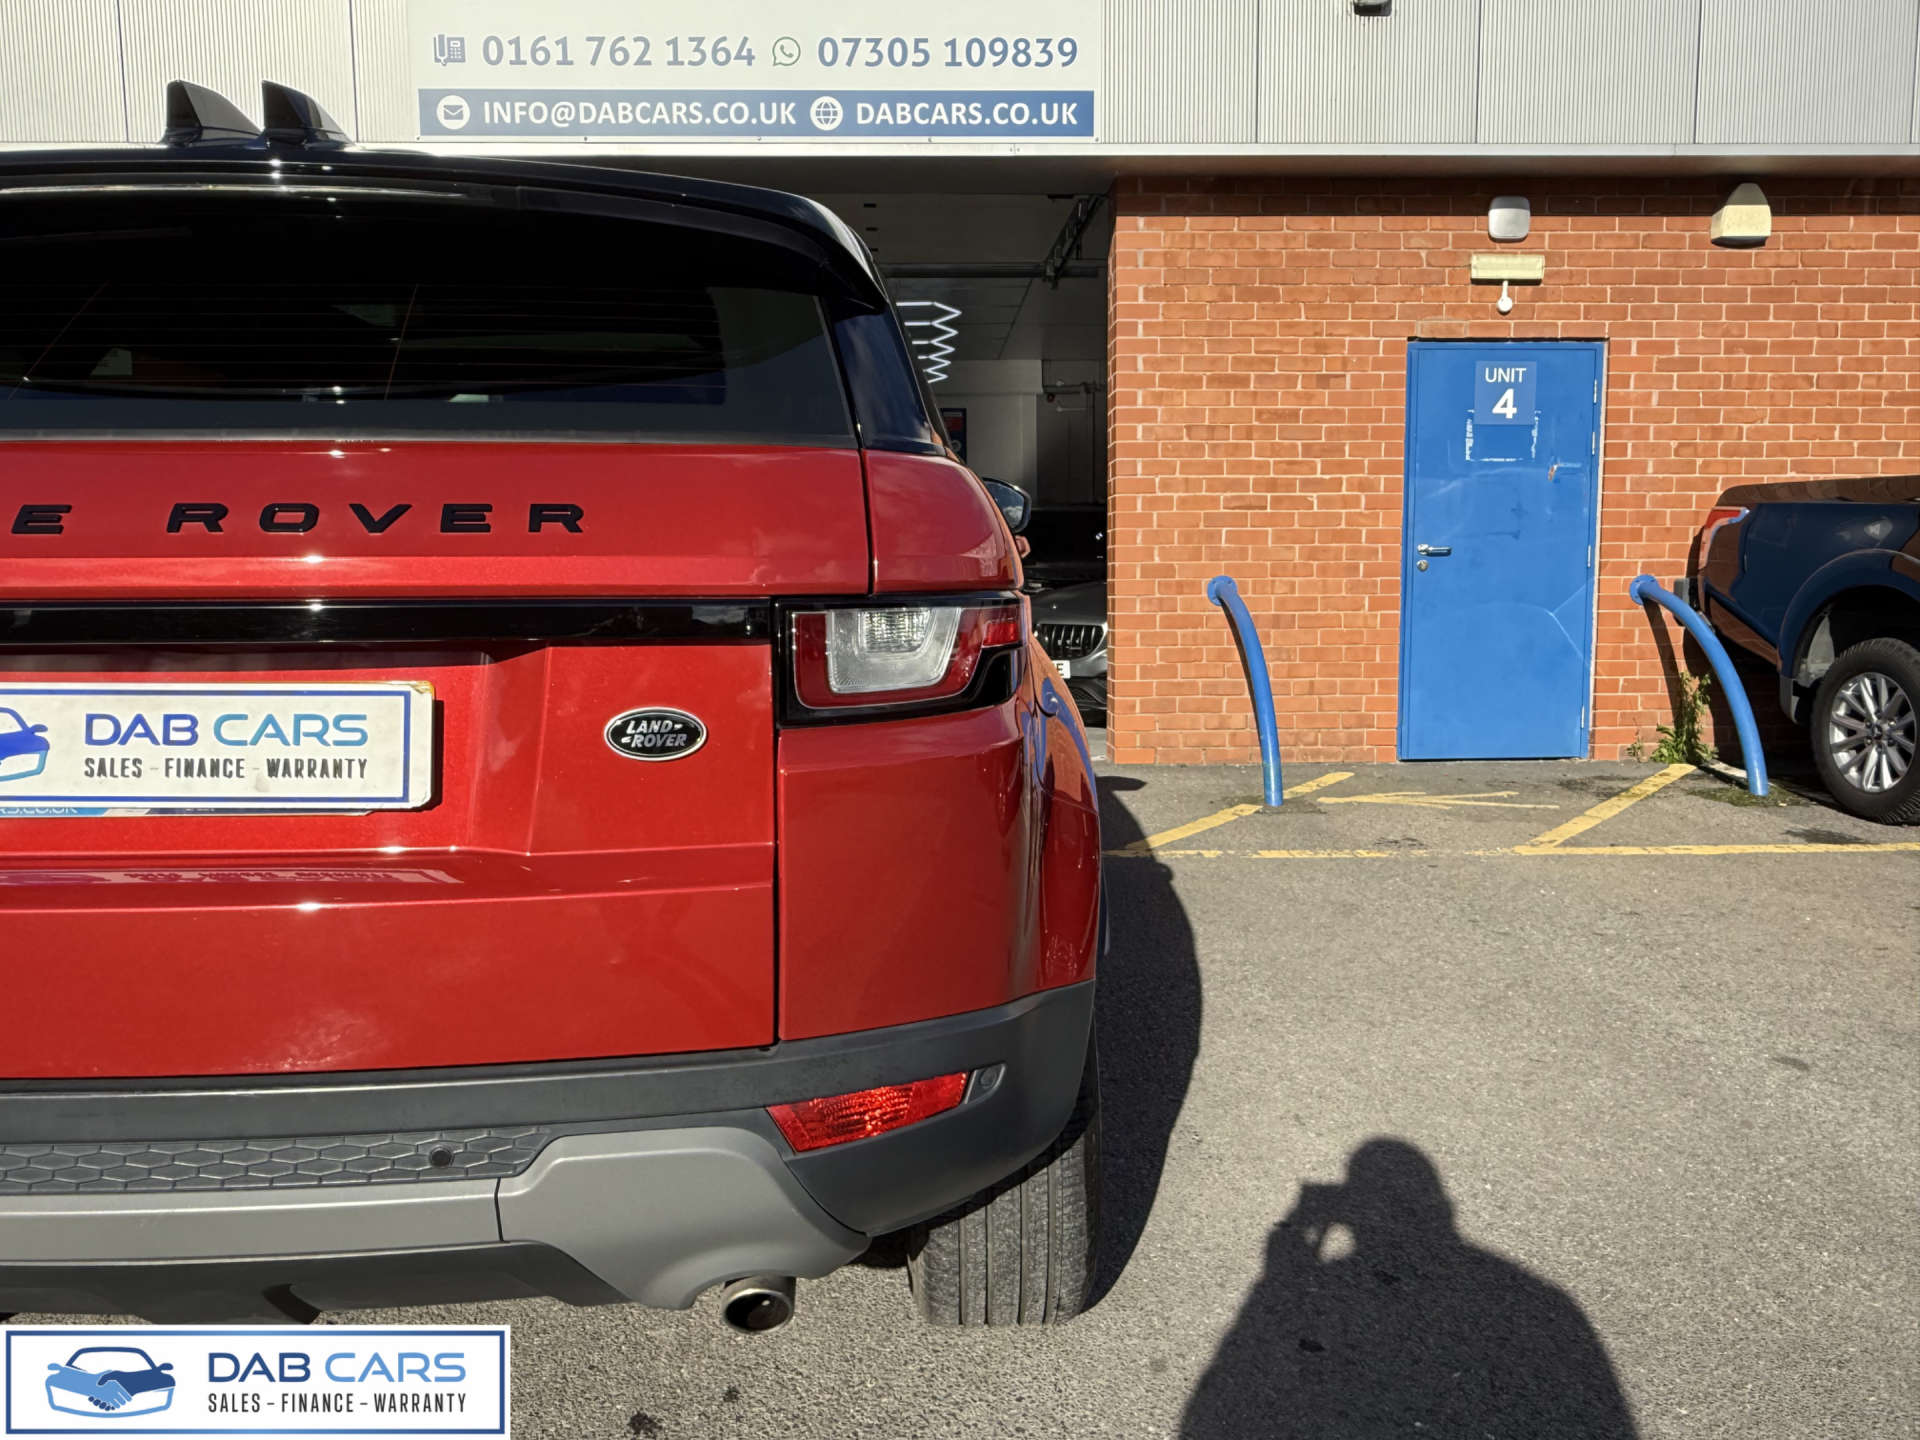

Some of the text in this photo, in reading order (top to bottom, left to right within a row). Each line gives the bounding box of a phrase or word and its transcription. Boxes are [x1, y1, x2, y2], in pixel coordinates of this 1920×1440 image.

[483, 35, 756, 67] 0161 762 1364
[818, 36, 1078, 67] 07305 109839
[484, 101, 796, 127] INFO@DABCARS.CO.UK
[856, 102, 1077, 125] DABCARS.CO.UK
[1485, 367, 1527, 383] UNIT
[1492, 388, 1518, 419] 4
[166, 503, 584, 535] ROVER
[85, 713, 369, 747] DAB CARS
[626, 720, 673, 734] LAND
[631, 733, 687, 747] ROVER
[84, 757, 143, 779] SALES
[164, 757, 246, 779] FINANCE
[266, 757, 368, 779] WARRANTY
